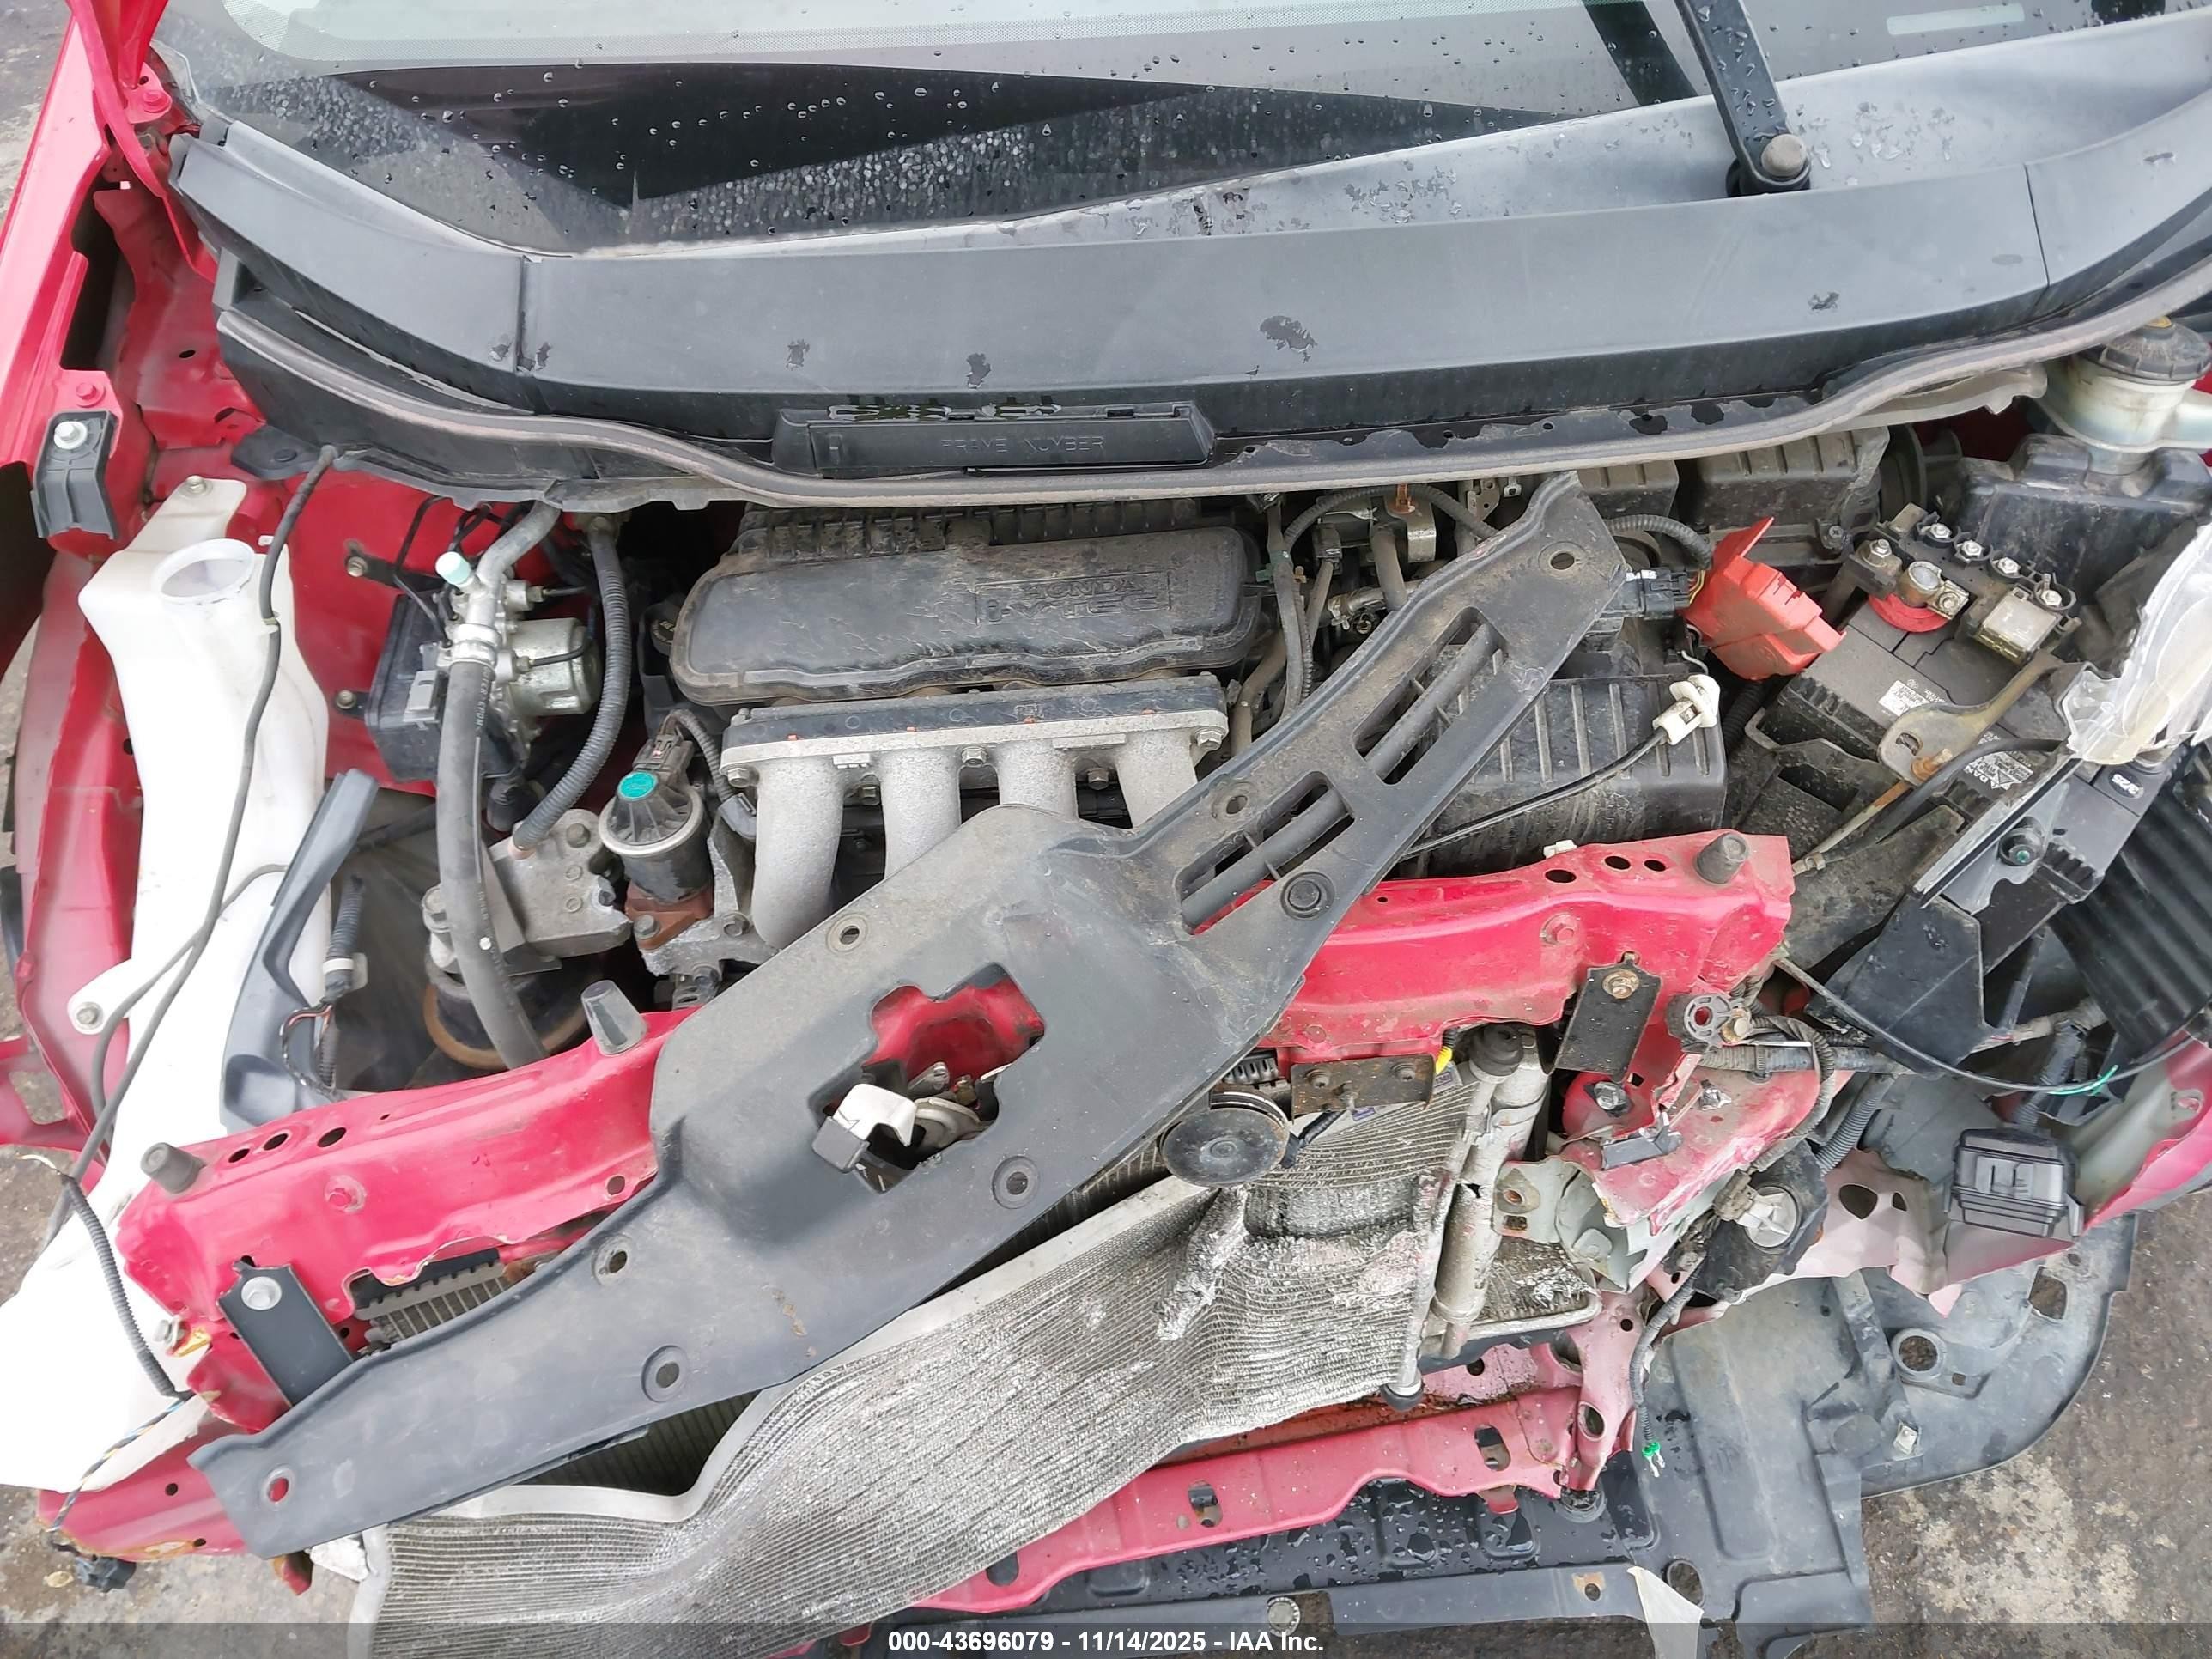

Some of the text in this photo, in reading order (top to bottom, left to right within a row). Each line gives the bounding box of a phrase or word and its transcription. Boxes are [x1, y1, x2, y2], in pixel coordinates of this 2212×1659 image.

[940, 435, 1106, 453] FRAME NUMBER
[1021, 579, 1147, 601] HONDA
[1964, 764, 1990, 784] DAN
[2111, 773, 2140, 795] 3/25
